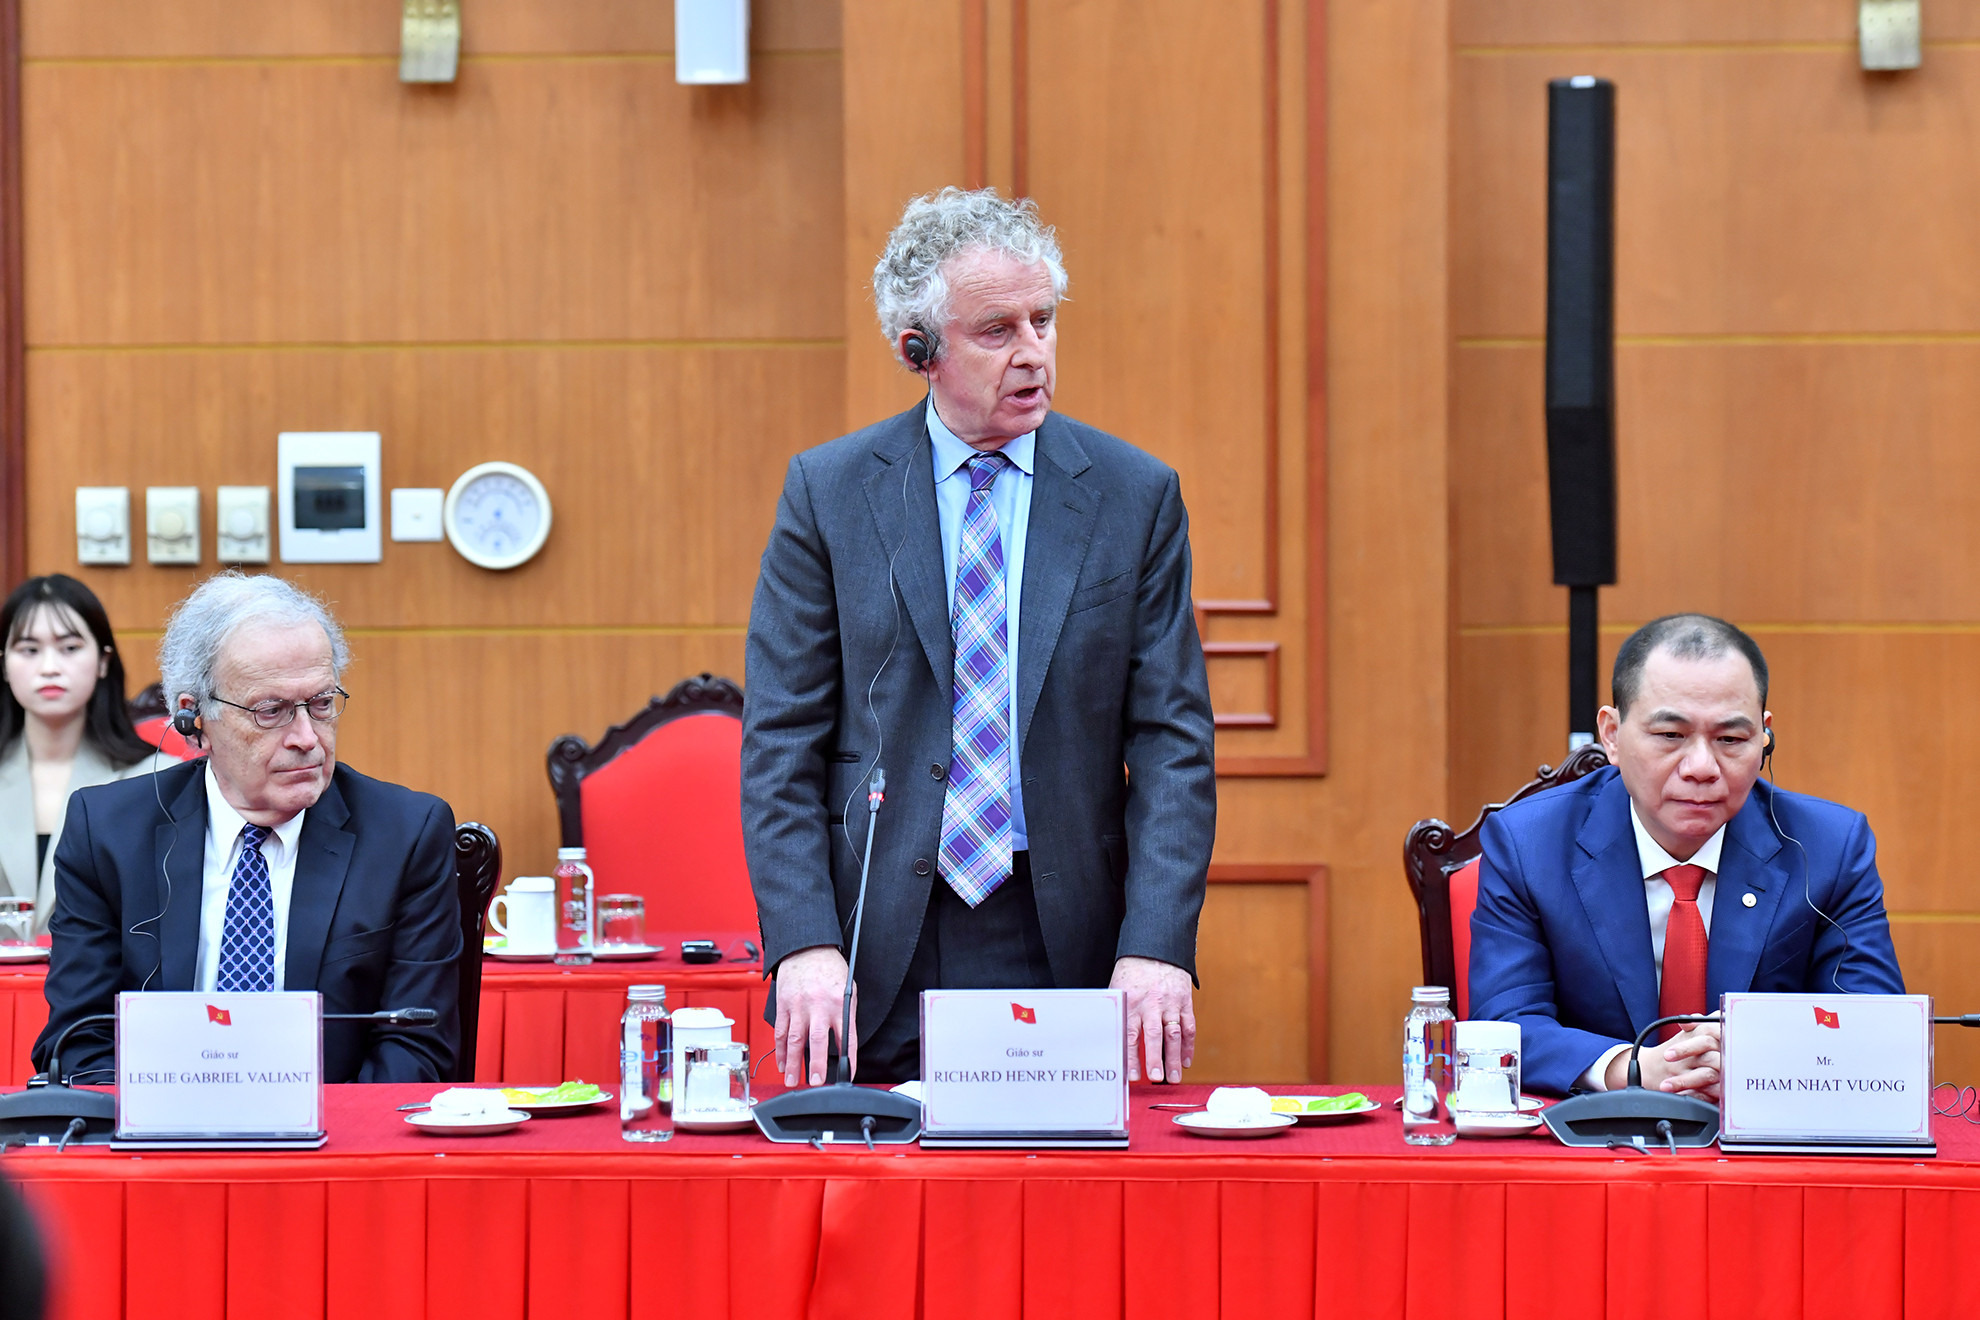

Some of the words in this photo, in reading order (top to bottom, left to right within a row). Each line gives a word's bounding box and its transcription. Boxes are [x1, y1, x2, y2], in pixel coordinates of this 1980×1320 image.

[200, 1049, 225, 1060] Giáo
[226, 1051, 239, 1060] sư
[1005, 1047, 1030, 1058] Giáo
[1031, 1049, 1044, 1058] sư
[1816, 1055, 1835, 1067] Mr.
[129, 1072, 177, 1084] LESLIE
[180, 1071, 243, 1084] GABRIEL
[247, 1071, 312, 1083] VALIANT
[934, 1070, 1002, 1083] RICHARD
[1006, 1070, 1057, 1082] HENRY
[1061, 1069, 1117, 1082] FRIEND
[1746, 1078, 1793, 1091] PHAM
[1796, 1078, 1843, 1092] NHAT
[1847, 1079, 1905, 1093] VUONG
